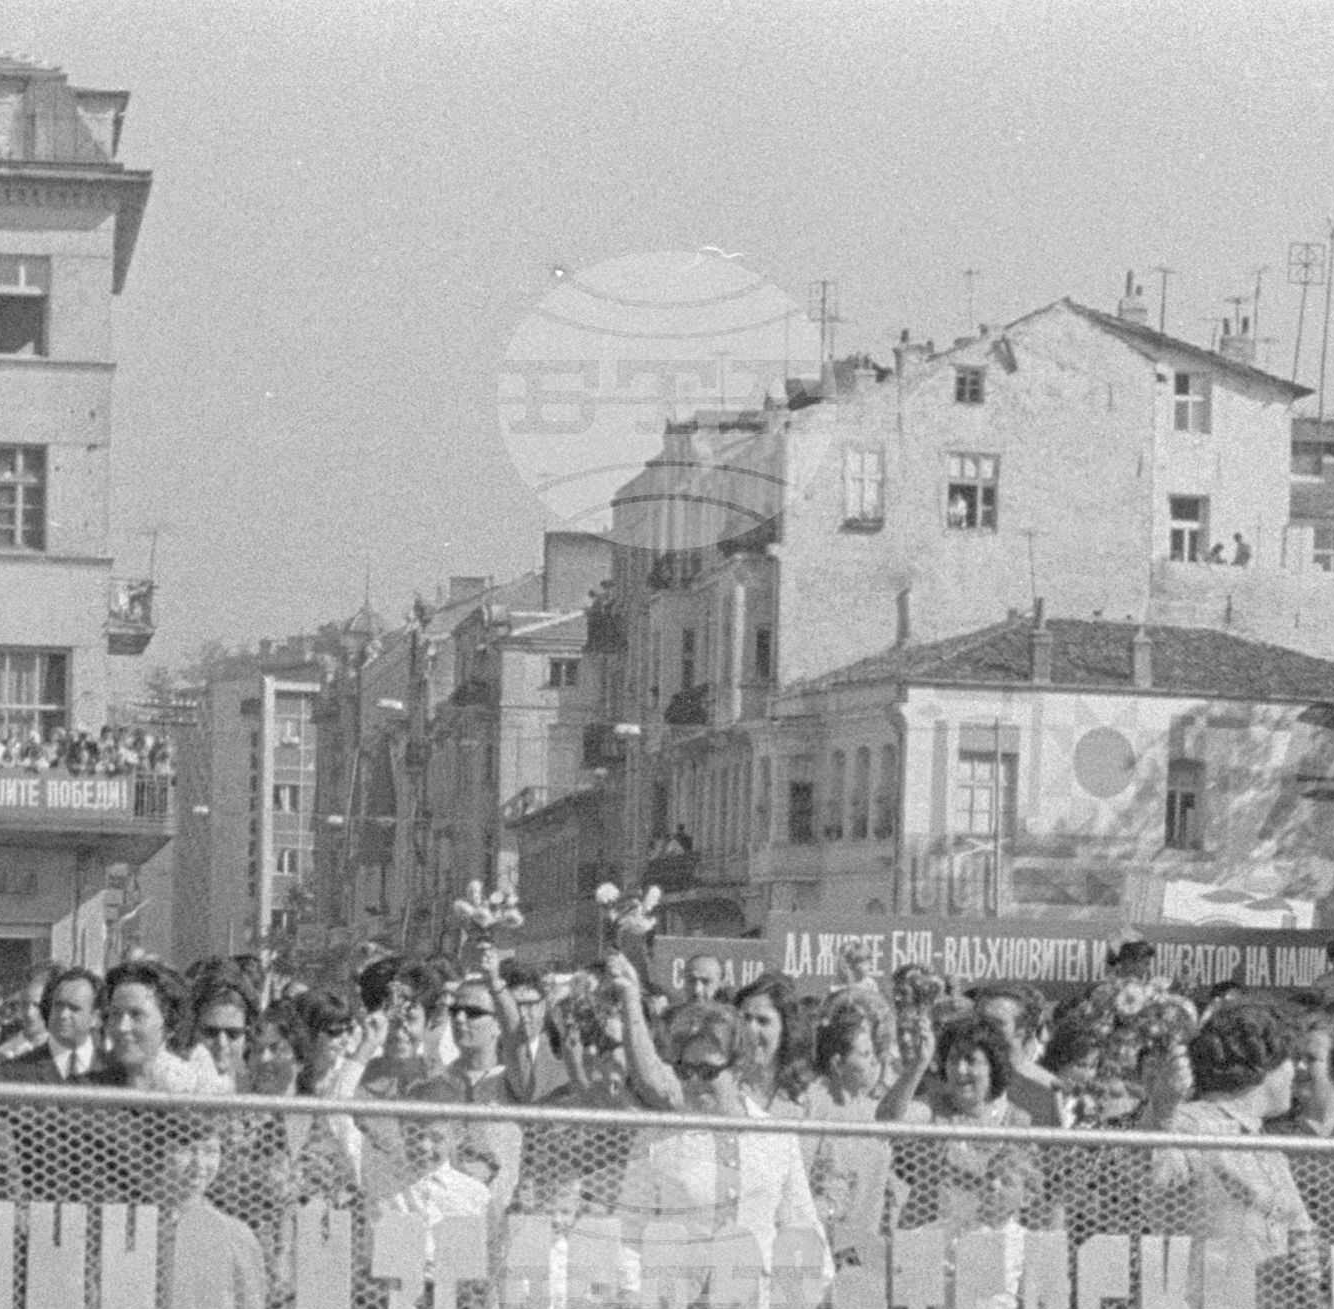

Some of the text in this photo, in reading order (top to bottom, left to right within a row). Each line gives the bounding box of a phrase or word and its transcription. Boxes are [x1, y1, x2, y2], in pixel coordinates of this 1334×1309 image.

[46, 780, 128, 809] ПОБЕДИ!
[781, 932, 812, 978] ДА
[1093, 940, 1108, 981] И
[1245, 946, 1270, 986] НА
